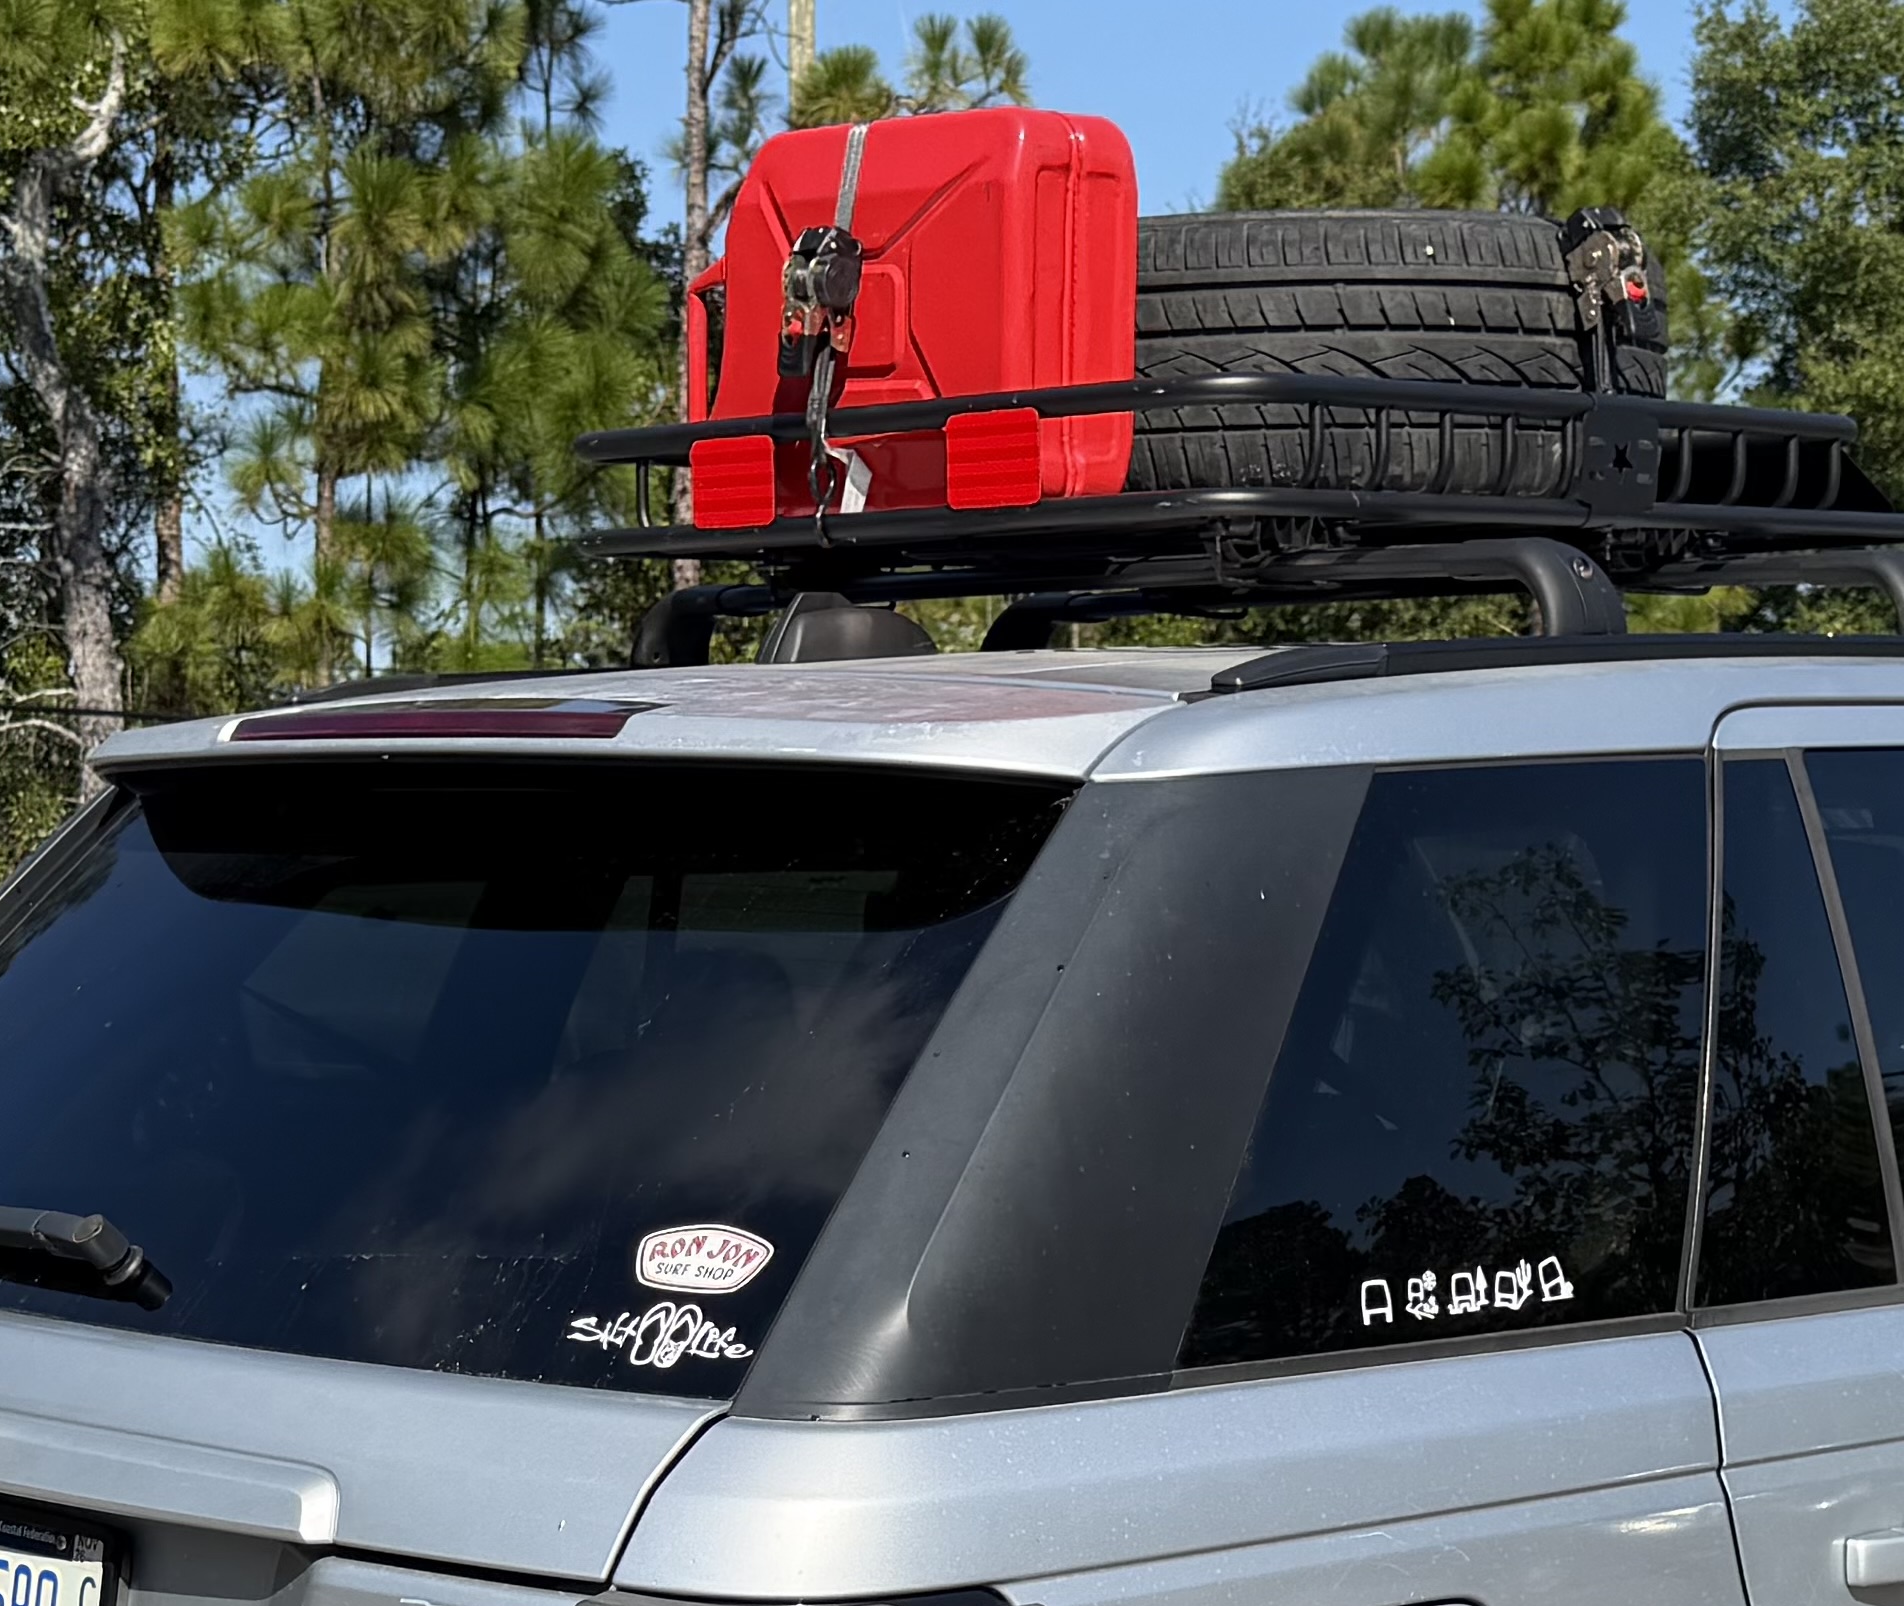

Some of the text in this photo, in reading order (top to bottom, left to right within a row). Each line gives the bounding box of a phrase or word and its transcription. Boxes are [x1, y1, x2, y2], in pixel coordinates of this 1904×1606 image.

[649, 1236, 760, 1269] RON JON
[655, 1263, 734, 1282] SURF SHOP
